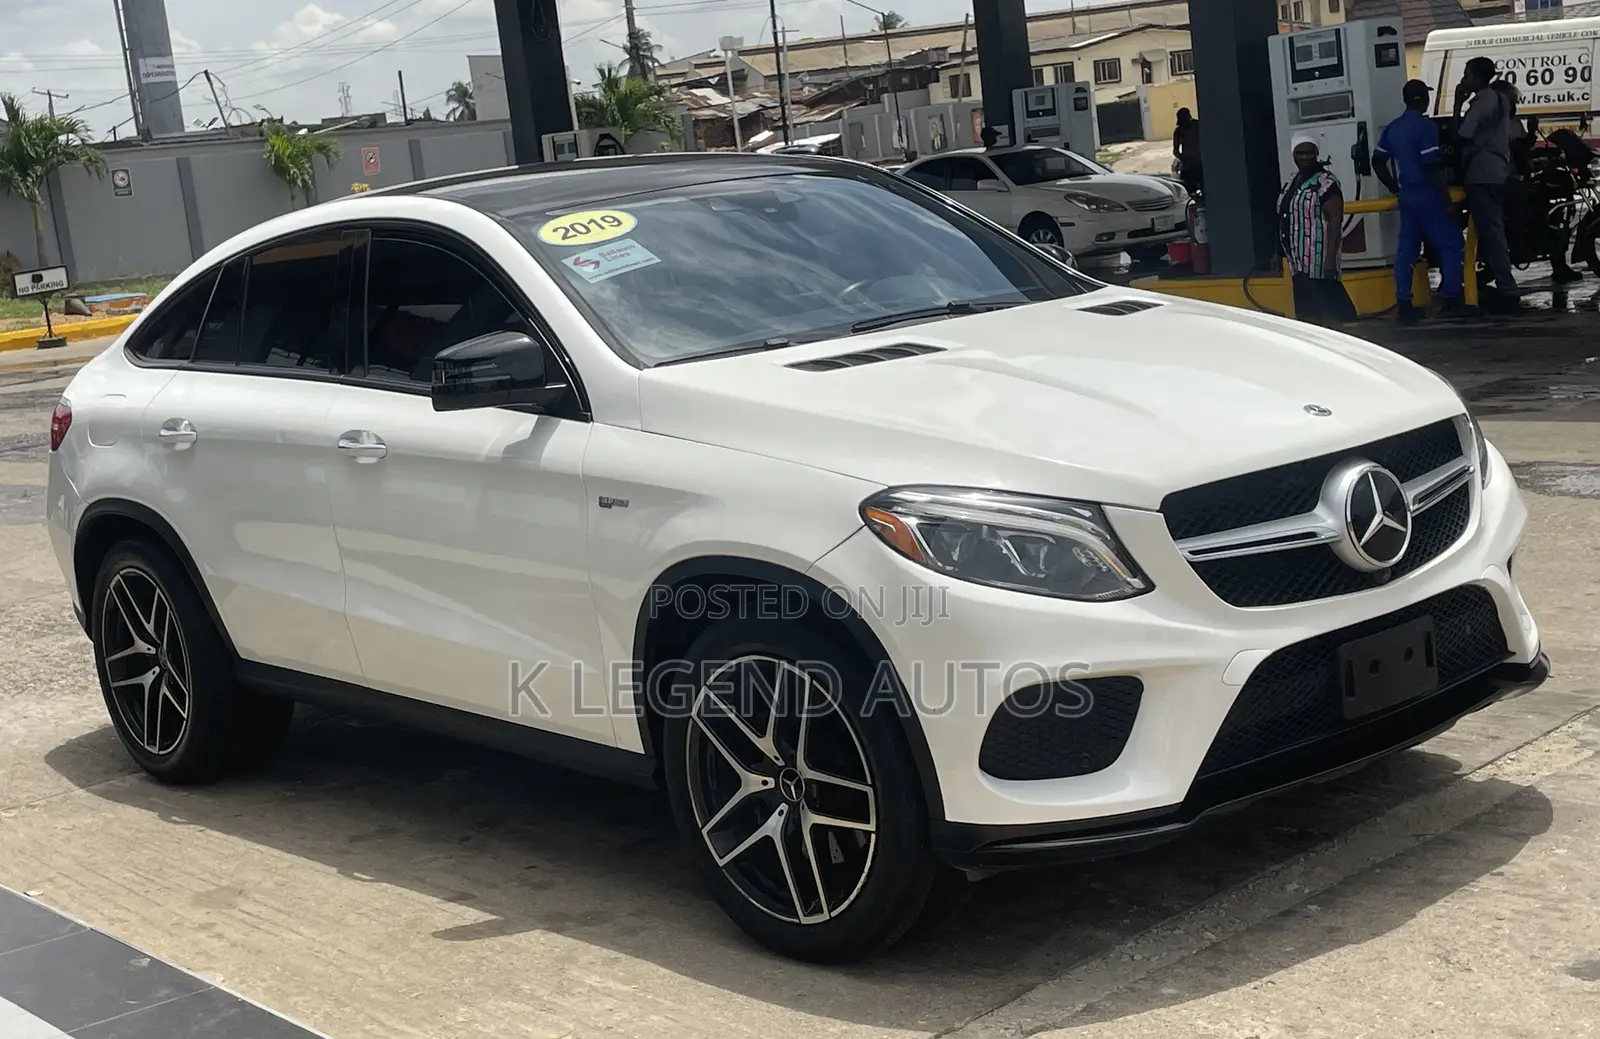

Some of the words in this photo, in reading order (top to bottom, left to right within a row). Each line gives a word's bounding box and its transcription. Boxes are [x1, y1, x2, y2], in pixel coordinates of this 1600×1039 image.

[1495, 33, 1544, 44] COMMERCIAL
[1546, 32, 1577, 40] VEHICLE
[1494, 55, 1572, 70] CONTROL
[1578, 53, 1590, 65] C
[1526, 68, 1554, 86] 60
[1564, 66, 1592, 84] 90
[552, 215, 623, 241] 2019
[18, 286, 30, 294] NO
[31, 280, 64, 292] PARKING
